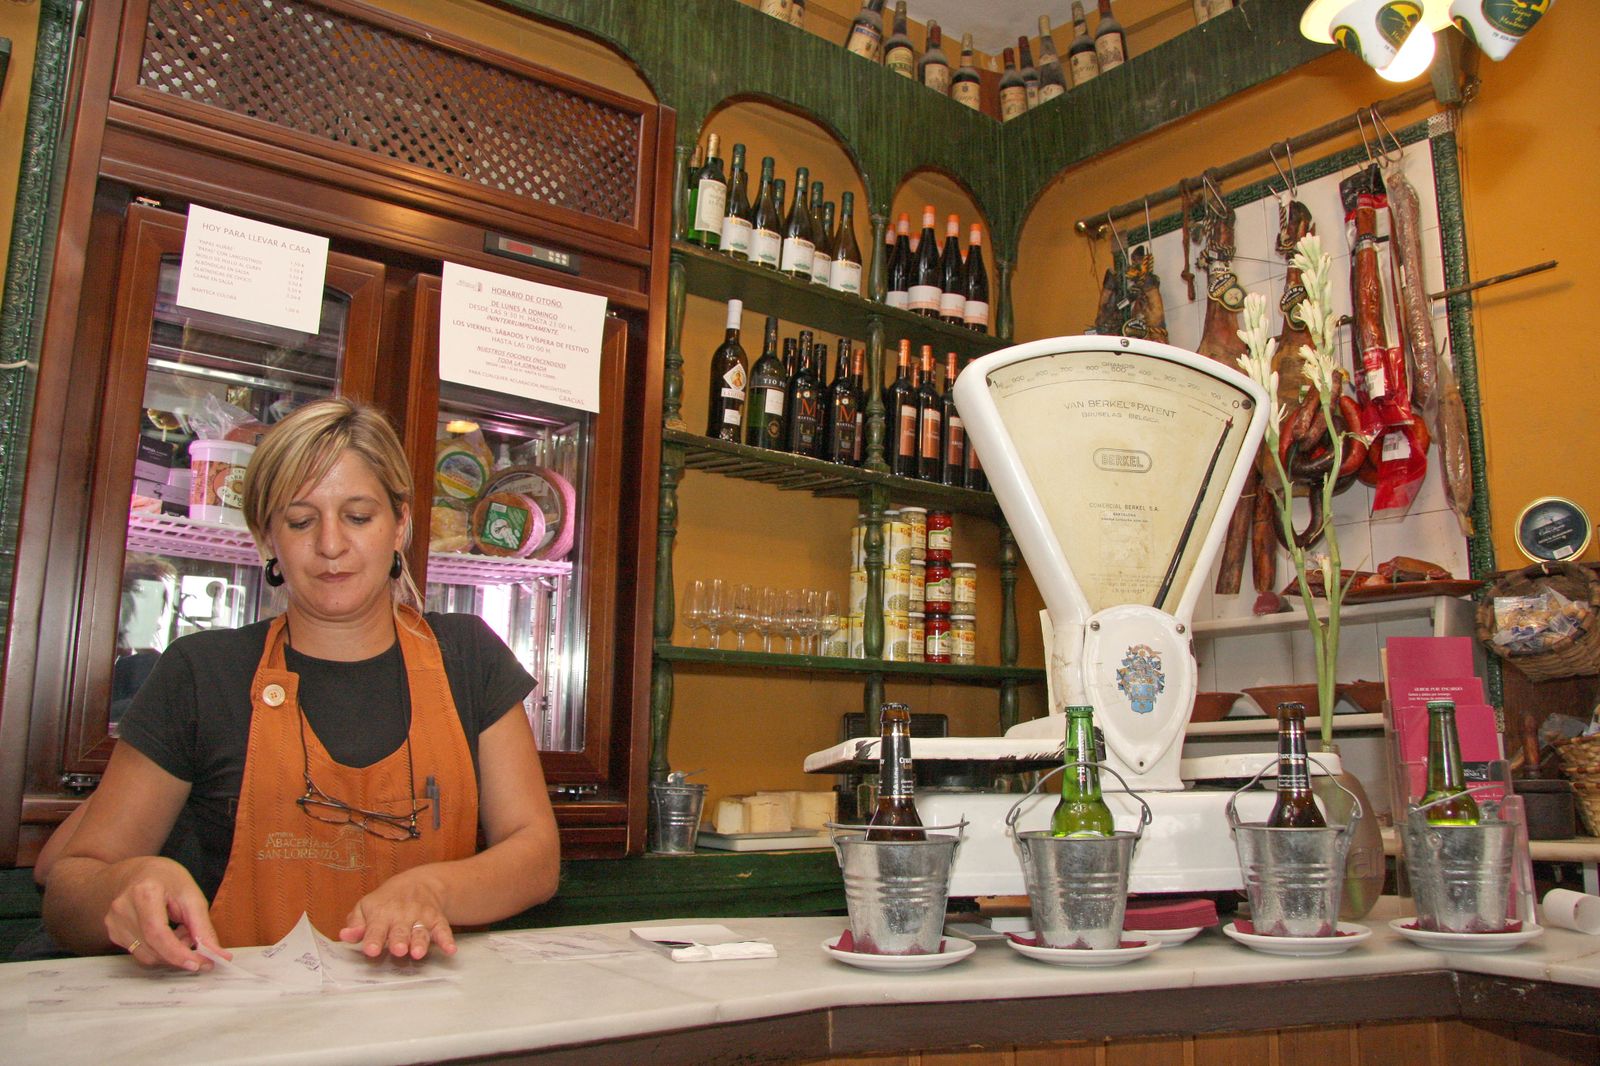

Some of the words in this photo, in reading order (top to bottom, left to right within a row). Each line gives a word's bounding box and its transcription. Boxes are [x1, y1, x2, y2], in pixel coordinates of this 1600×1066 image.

[202, 222, 220, 233] HOY
[224, 228, 246, 239] PARA
[248, 234, 278, 247] LLEVAR
[281, 241, 287, 249] A
[289, 243, 311, 254] CASA
[491, 286, 523, 301] HORARIO
[525, 294, 534, 303] DE
[469, 303, 488, 313] DESDE
[528, 316, 547, 325] HASTA
[502, 303, 520, 312] LUNES
[528, 308, 558, 320] DOMINGO
[453, 319, 465, 327] LOS
[495, 328, 523, 340] SÁBADOS
[565, 343, 589, 354] FESTIVO
[492, 336, 512, 346] HASTA
[477, 345, 505, 356] NUESTROS
[506, 351, 532, 362] FOGONES
[533, 357, 566, 369] ENCENDIDOS
[498, 357, 512, 365] TODA
[522, 362, 546, 372] JORNADA
[559, 395, 585, 405] GRACIAS
[1064, 400, 1085, 410] VAN
[1136, 403, 1177, 419] PATENT
[1102, 454, 1144, 468] BERKEL
[1089, 502, 1122, 510] COMERCIAL
[1124, 504, 1147, 512] BERKEL
[258, 850, 282, 860] SAN
[284, 848, 340, 860] LORENZO
